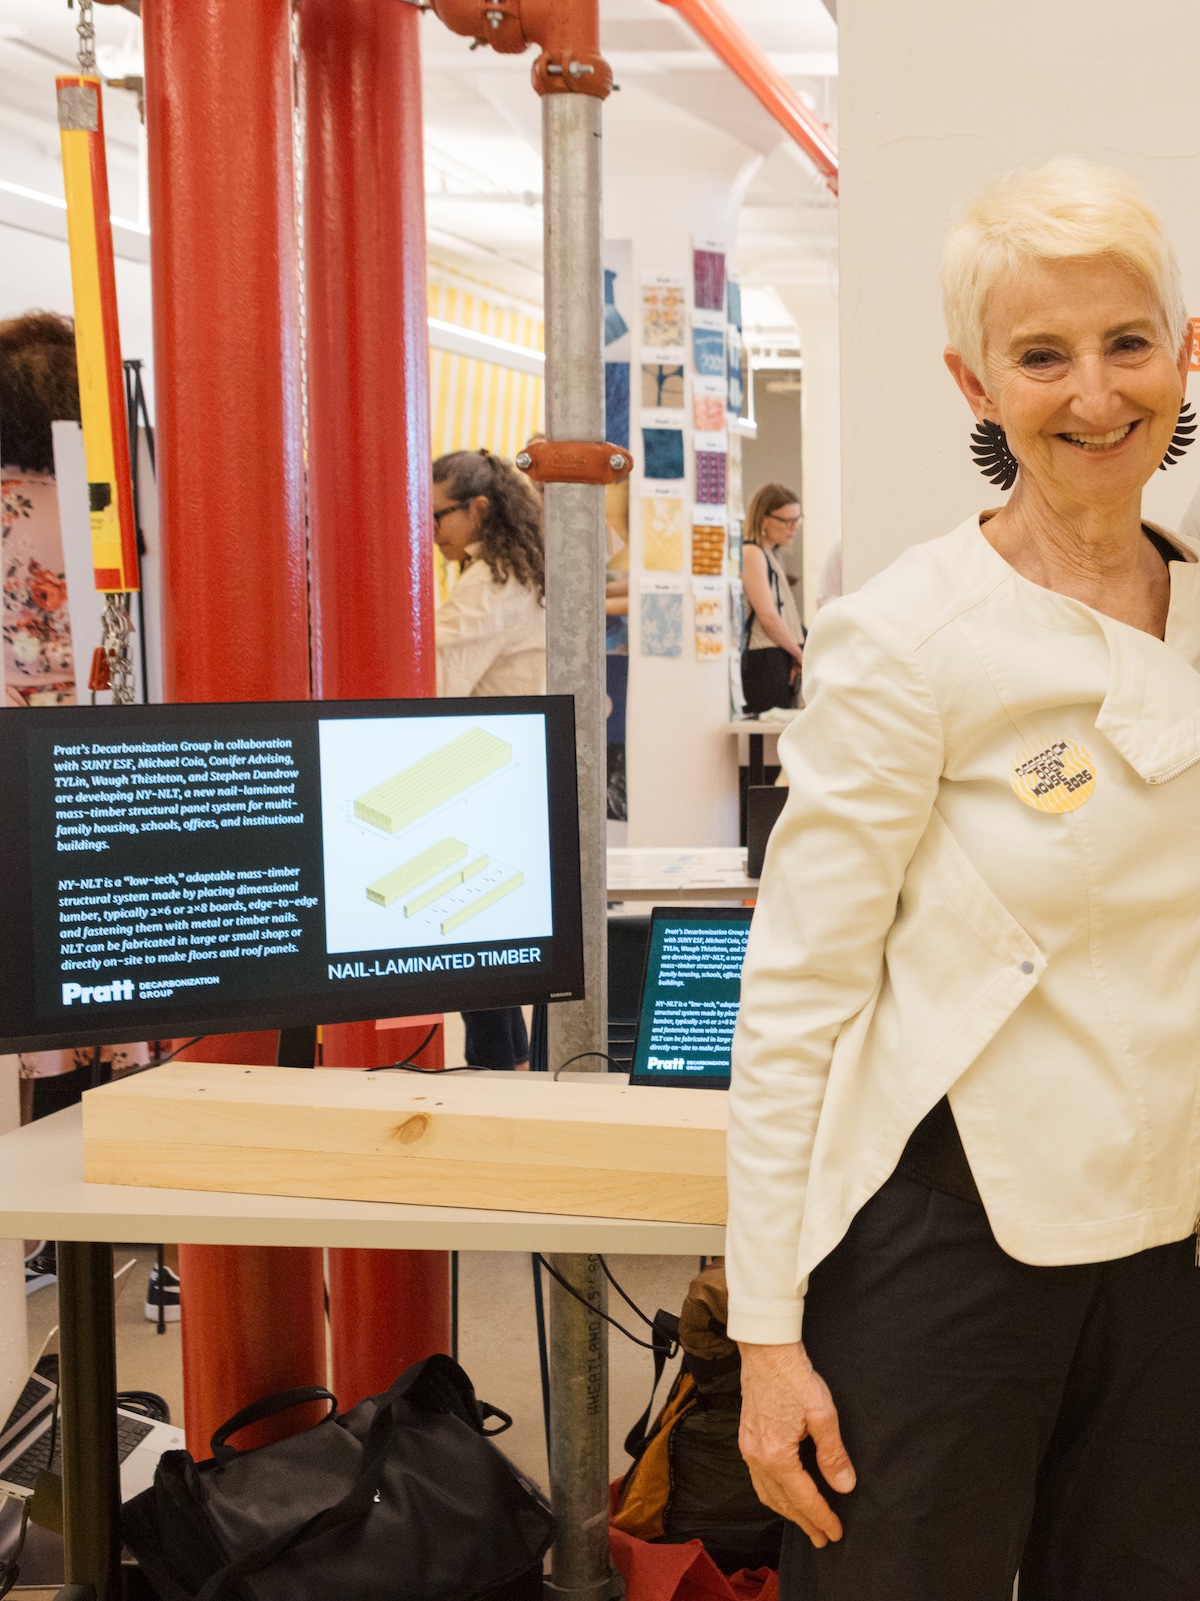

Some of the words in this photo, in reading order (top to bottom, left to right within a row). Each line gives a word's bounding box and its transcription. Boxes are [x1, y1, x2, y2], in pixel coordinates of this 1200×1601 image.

[53, 743, 89, 755] Pratt's
[91, 741, 178, 754] Decarbonization
[180, 741, 211, 753] Group
[213, 740, 224, 750] in
[225, 738, 292, 753] collaboration
[53, 760, 79, 771] with
[80, 759, 112, 770] SUNY
[113, 758, 136, 770] ESF,
[137, 756, 179, 768] Michael
[180, 756, 207, 771] Coia,
[208, 754, 246, 770] Conifer
[247, 753, 293, 770] Advising,
[1015, 740, 1069, 779] RESEARCH
[1036, 758, 1065, 780] OPEN
[54, 775, 90, 788] TYLin,
[90, 774, 128, 788] Waugh
[130, 773, 186, 784] Thistleton,
[187, 771, 208, 782] and
[209, 770, 250, 785] Stephen
[252, 768, 299, 784] Dandrow
[1032, 771, 1067, 798] HOUSE
[1064, 769, 1093, 792] 2026
[54, 794, 73, 803] are
[75, 790, 133, 803] developing
[135, 788, 182, 800] NY-NLT,
[193, 788, 215, 797] new
[217, 783, 294, 800] nail-laminated
[56, 806, 126, 819] mass-timber
[128, 803, 178, 816] structural
[180, 802, 209, 816] panel
[211, 802, 246, 814] system
[246, 800, 263, 812] for
[264, 798, 297, 814] multi-
[54, 823, 92, 838] family
[93, 822, 139, 834] housing,
[140, 819, 181, 831] schools,
[183, 818, 219, 831] offices,
[220, 816, 240, 827] and
[242, 813, 303, 825] institutional
[57, 839, 109, 851] buildings.
[58, 878, 103, 890] NY-NLT
[104, 877, 112, 887] is
[123, 872, 184, 886] "low-tech,"
[185, 870, 235, 883] adaptable
[237, 866, 300, 881] mass-timber
[58, 893, 111, 906] structural
[112, 893, 149, 905] system
[151, 889, 181, 900] made
[182, 888, 196, 900] by
[197, 886, 235, 899] placing
[236, 881, 298, 894] dimensional
[59, 911, 101, 922] lumber,
[103, 907, 148, 921] typically
[173, 906, 185, 914] or
[209, 900, 246, 912] boards,
[248, 896, 318, 912] edge-to-edge
[59, 927, 81, 938] and
[82, 924, 133, 939] fastening
[135, 922, 162, 933] them
[164, 919, 188, 930] with
[191, 917, 220, 928] metal
[222, 918, 234, 926] or
[235, 914, 270, 925] timber
[271, 912, 298, 922] nails.
[60, 943, 84, 954] NLT
[85, 943, 104, 952] can
[107, 941, 120, 950] be
[120, 936, 175, 952] fabricated
[177, 935, 188, 945] in
[190, 934, 216, 945] large
[218, 934, 230, 942] or
[231, 929, 259, 941] small
[261, 929, 289, 940] shops
[290, 929, 302, 937] or
[60, 958, 101, 970] directly
[103, 955, 142, 966] on-site
[144, 955, 156, 963] to
[157, 951, 186, 962] make
[187, 950, 217, 962] floors
[219, 946, 239, 957] and
[241, 944, 263, 957] roof
[263, 942, 298, 956] panels.
[328, 953, 474, 979] NAIL-LAMINATED
[477, 947, 540, 966] TIMBER
[62, 979, 134, 1005] Pratt
[139, 976, 219, 991] DECARBONIZATION
[139, 989, 173, 998] GROUP
[647, 1057, 685, 1069] Pratt
[587, 1321, 601, 1416] WHEATLAND
